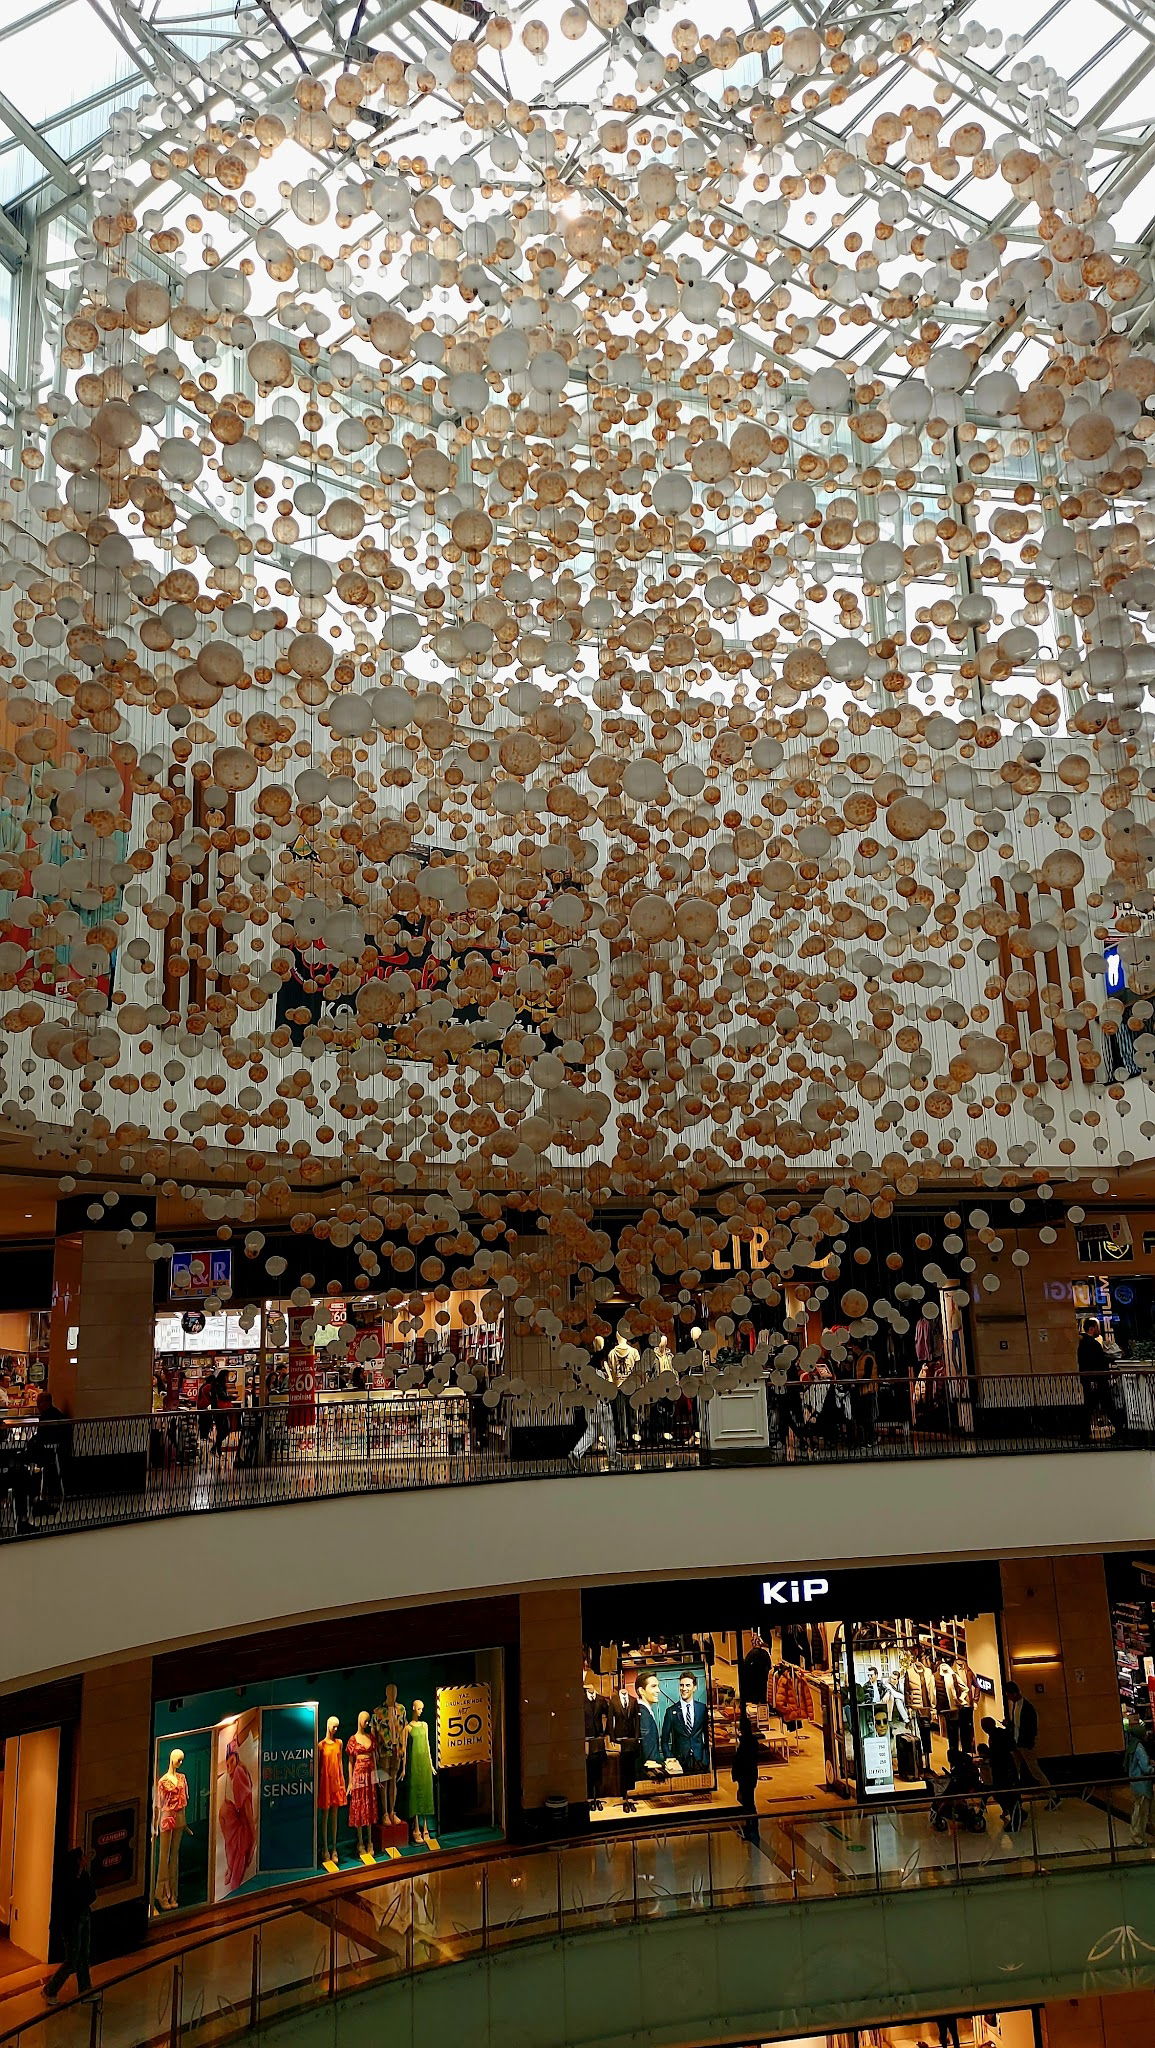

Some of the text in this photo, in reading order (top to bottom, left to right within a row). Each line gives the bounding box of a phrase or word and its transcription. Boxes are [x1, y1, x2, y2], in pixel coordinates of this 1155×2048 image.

[447, 1713, 483, 1737] 50
[263, 1748, 314, 1762] BU YAZIN
[263, 1778, 314, 1797] SENSİN
